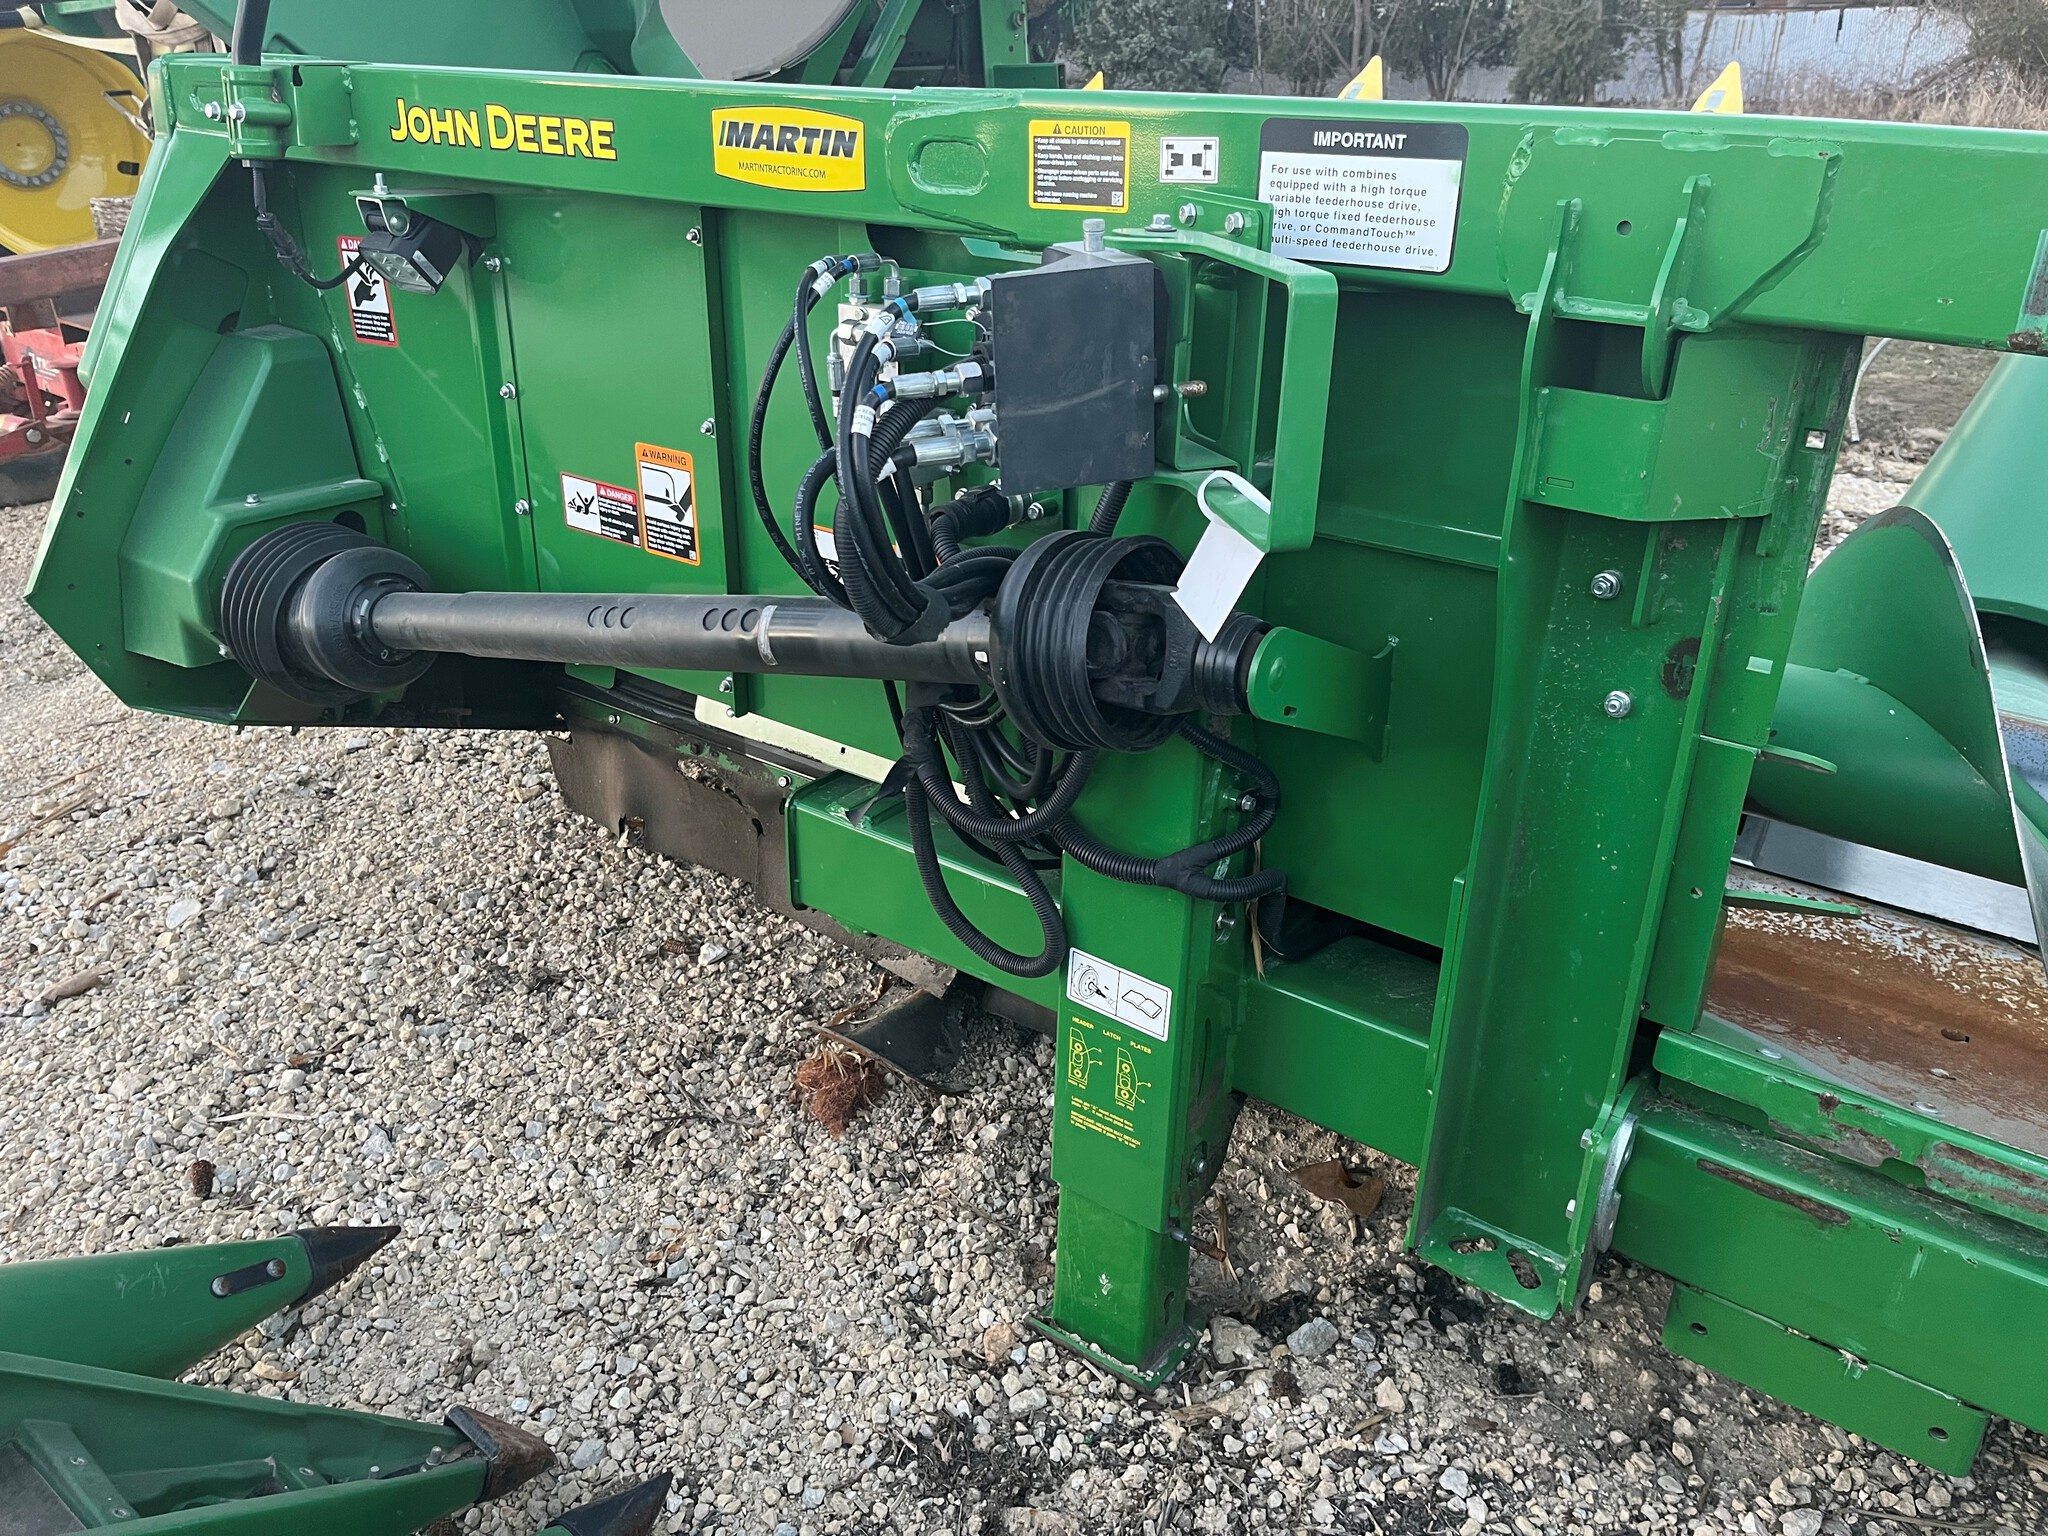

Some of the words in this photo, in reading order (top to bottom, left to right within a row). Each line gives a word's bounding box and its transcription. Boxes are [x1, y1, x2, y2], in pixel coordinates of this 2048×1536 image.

[390, 97, 482, 148] JOHN
[485, 103, 617, 160] DEERE
[1065, 126, 1105, 135] CAUTION
[726, 121, 857, 158] MARTIN
[1314, 131, 1407, 150] IMPORTANT
[739, 162, 826, 178] MARTINTRACTORINC.COM
[1271, 164, 1289, 174] For
[1293, 168, 1312, 176] use
[1316, 167, 1338, 177] with
[1343, 169, 1397, 181] combines
[1270, 179, 1319, 191] equipped
[1323, 182, 1346, 192] with
[1350, 185, 1357, 193] a
[1361, 184, 1386, 196] high
[1390, 186, 1427, 198] torque
[1269, 193, 1311, 204] variable
[1315, 196, 1384, 209] feederhouse
[1389, 200, 1421, 212] drive,
[1275, 208, 1291, 217] igh
[1295, 210, 1329, 220] torque
[1334, 211, 1361, 222] fixed
[1365, 213, 1436, 227] feederhouse
[1274, 222, 1297, 232] rive,
[1332, 239, 1401, 254] feederhouse
[1405, 245, 1438, 257] drive.
[649, 450, 686, 466] WARNING
[606, 489, 633, 503] DANGER
[1072, 1016, 1095, 1030] HEADER
[1103, 1030, 1121, 1041] LATCH
[1130, 1041, 1152, 1054] PLATES
